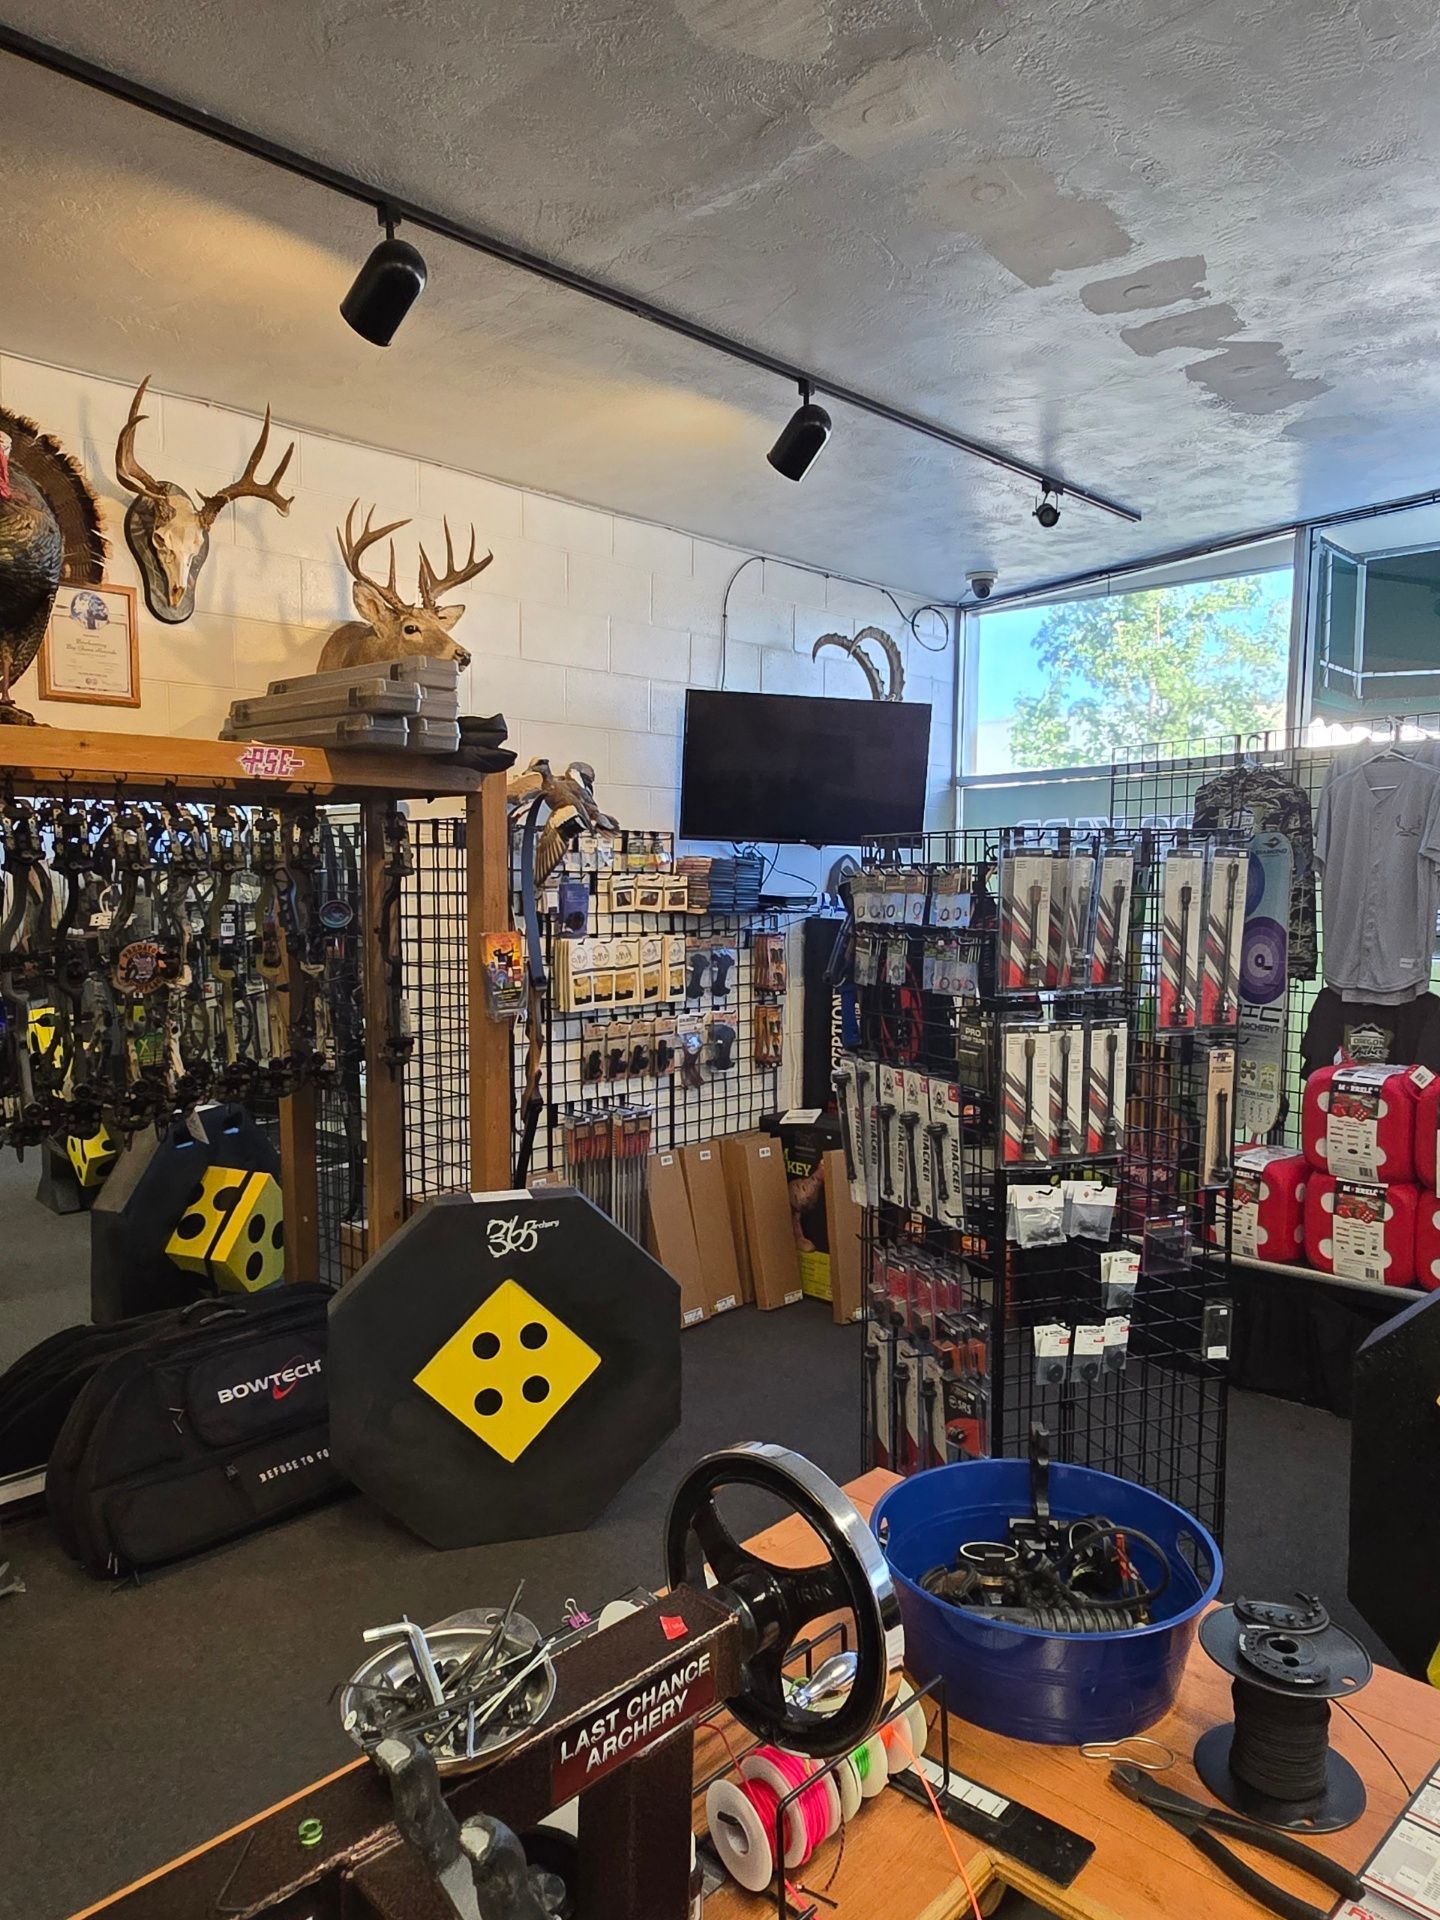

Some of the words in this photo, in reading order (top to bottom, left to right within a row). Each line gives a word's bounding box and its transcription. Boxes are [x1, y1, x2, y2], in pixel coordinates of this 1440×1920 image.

[246, 747, 294, 776] PSE
[831, 993, 843, 1092] CEPTION
[965, 1027, 981, 1037] PRO
[787, 1161, 812, 1177] KEY
[950, 1138, 961, 1194] TRACKER
[486, 1215, 538, 1258] 365
[217, 1359, 322, 1404] BOWTECH
[259, 1460, 299, 1483] REFUSE
[300, 1455, 314, 1466] TO
[316, 1448, 331, 1459] FO
[560, 1708, 620, 1764] LAST
[626, 1652, 711, 1720] CHANCE
[586, 1689, 688, 1774] ARCHERY
